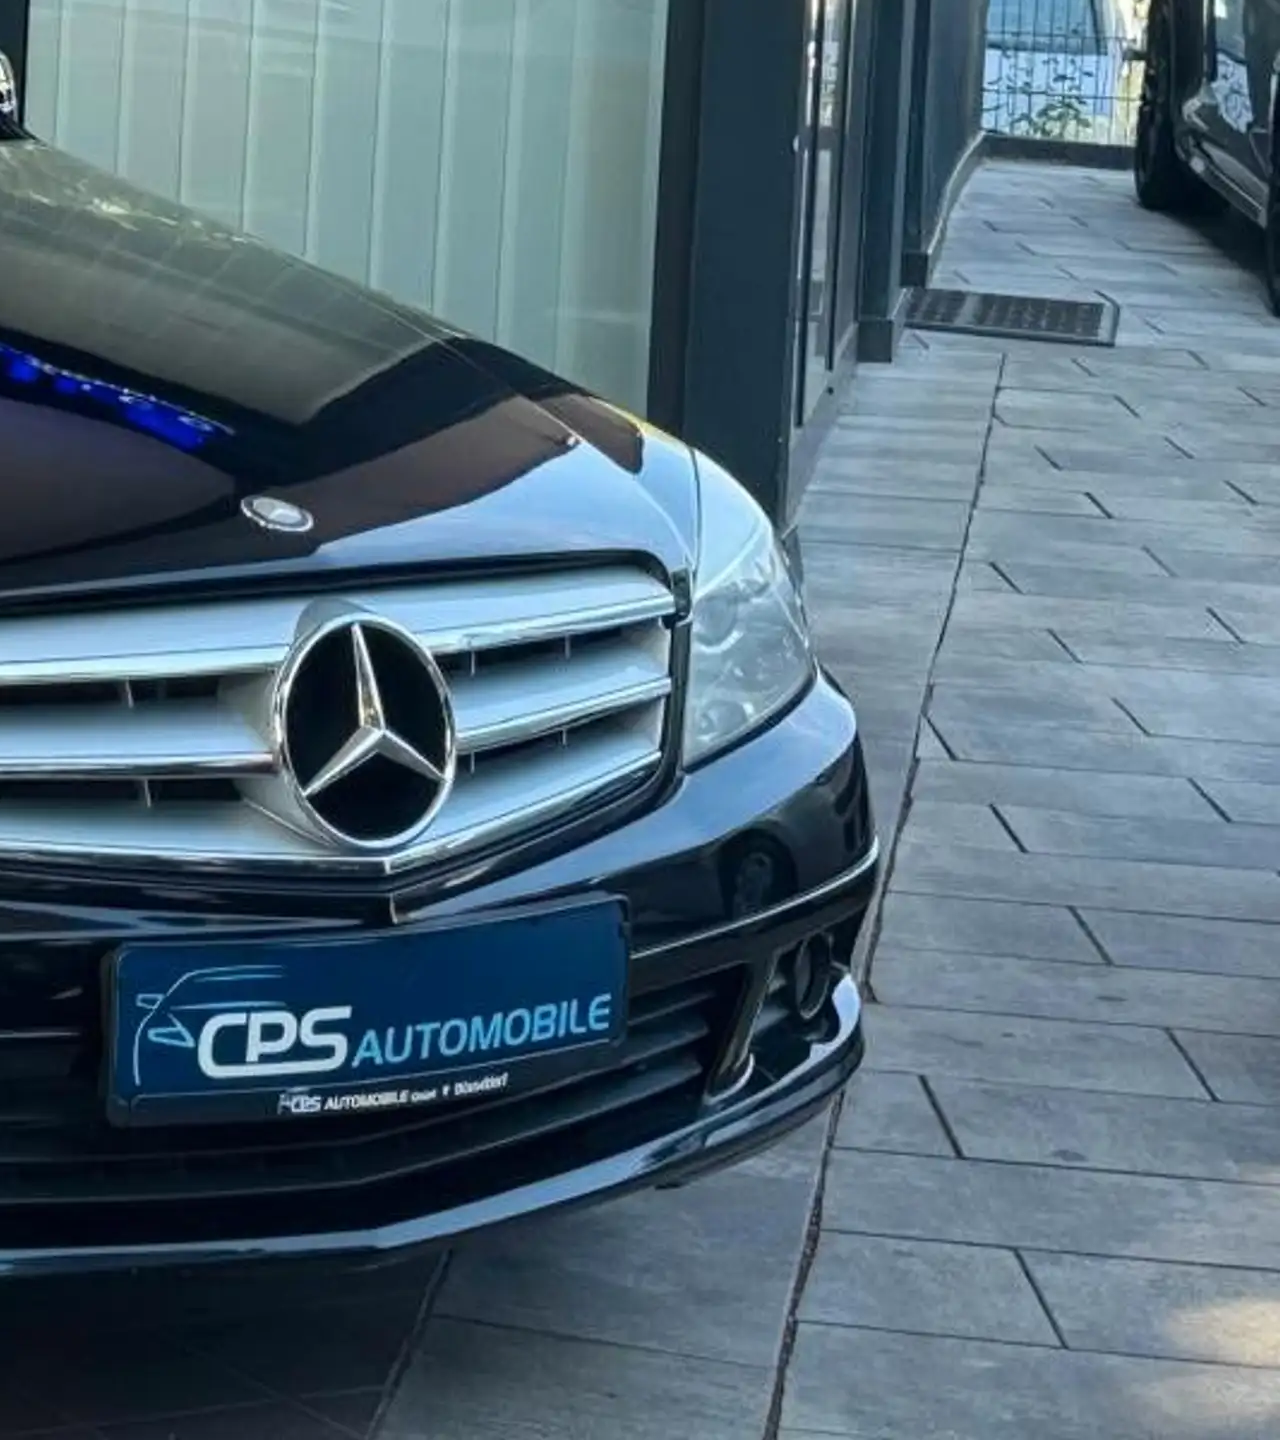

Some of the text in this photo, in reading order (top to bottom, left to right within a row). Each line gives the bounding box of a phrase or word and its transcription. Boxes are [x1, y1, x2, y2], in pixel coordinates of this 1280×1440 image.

[197, 992, 612, 1079] CPS AUTOMOBILE
[323, 1090, 409, 1110] AUTOMOBILE
